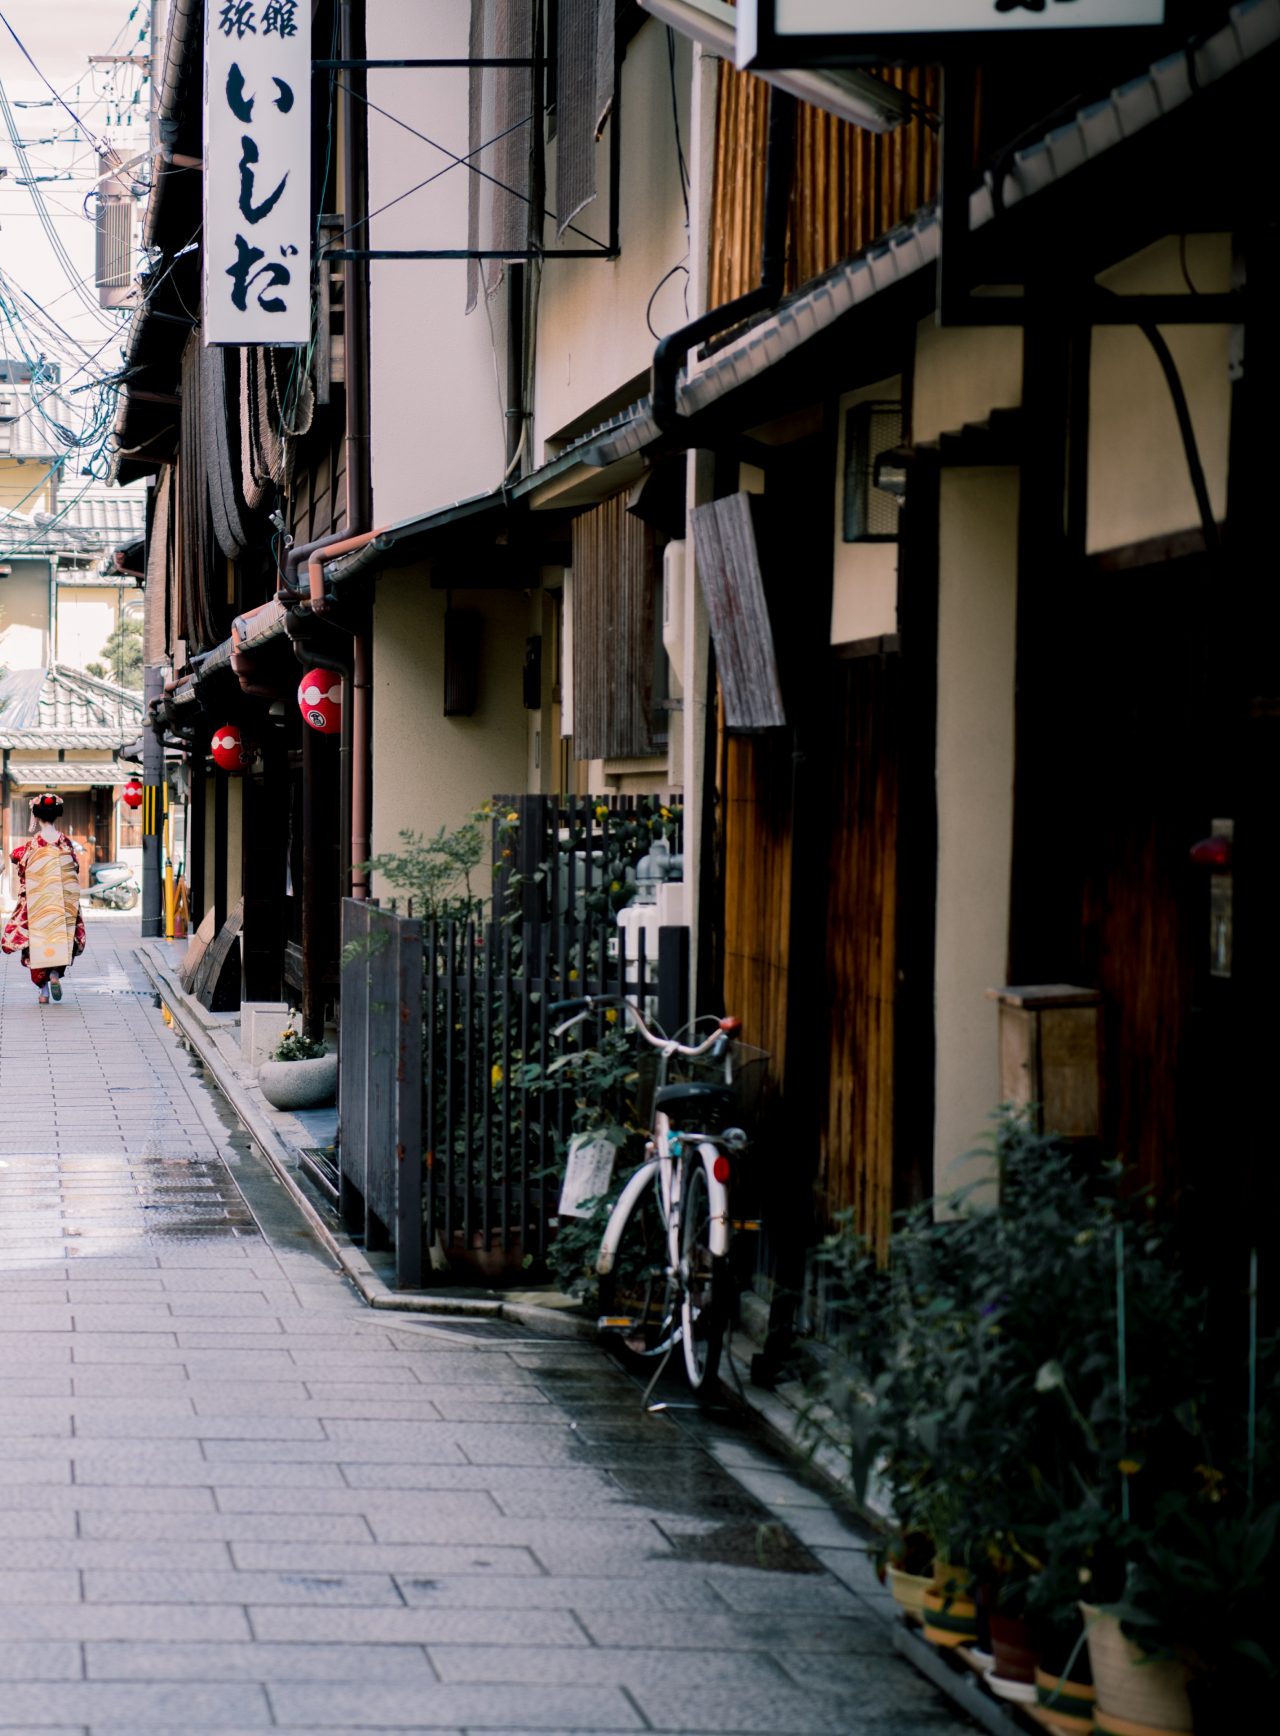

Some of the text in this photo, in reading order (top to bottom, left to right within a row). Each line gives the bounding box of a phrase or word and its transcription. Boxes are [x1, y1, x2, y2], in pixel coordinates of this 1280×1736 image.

[217, 0, 299, 40] 旅館
[225, 62, 299, 313] いしだ
